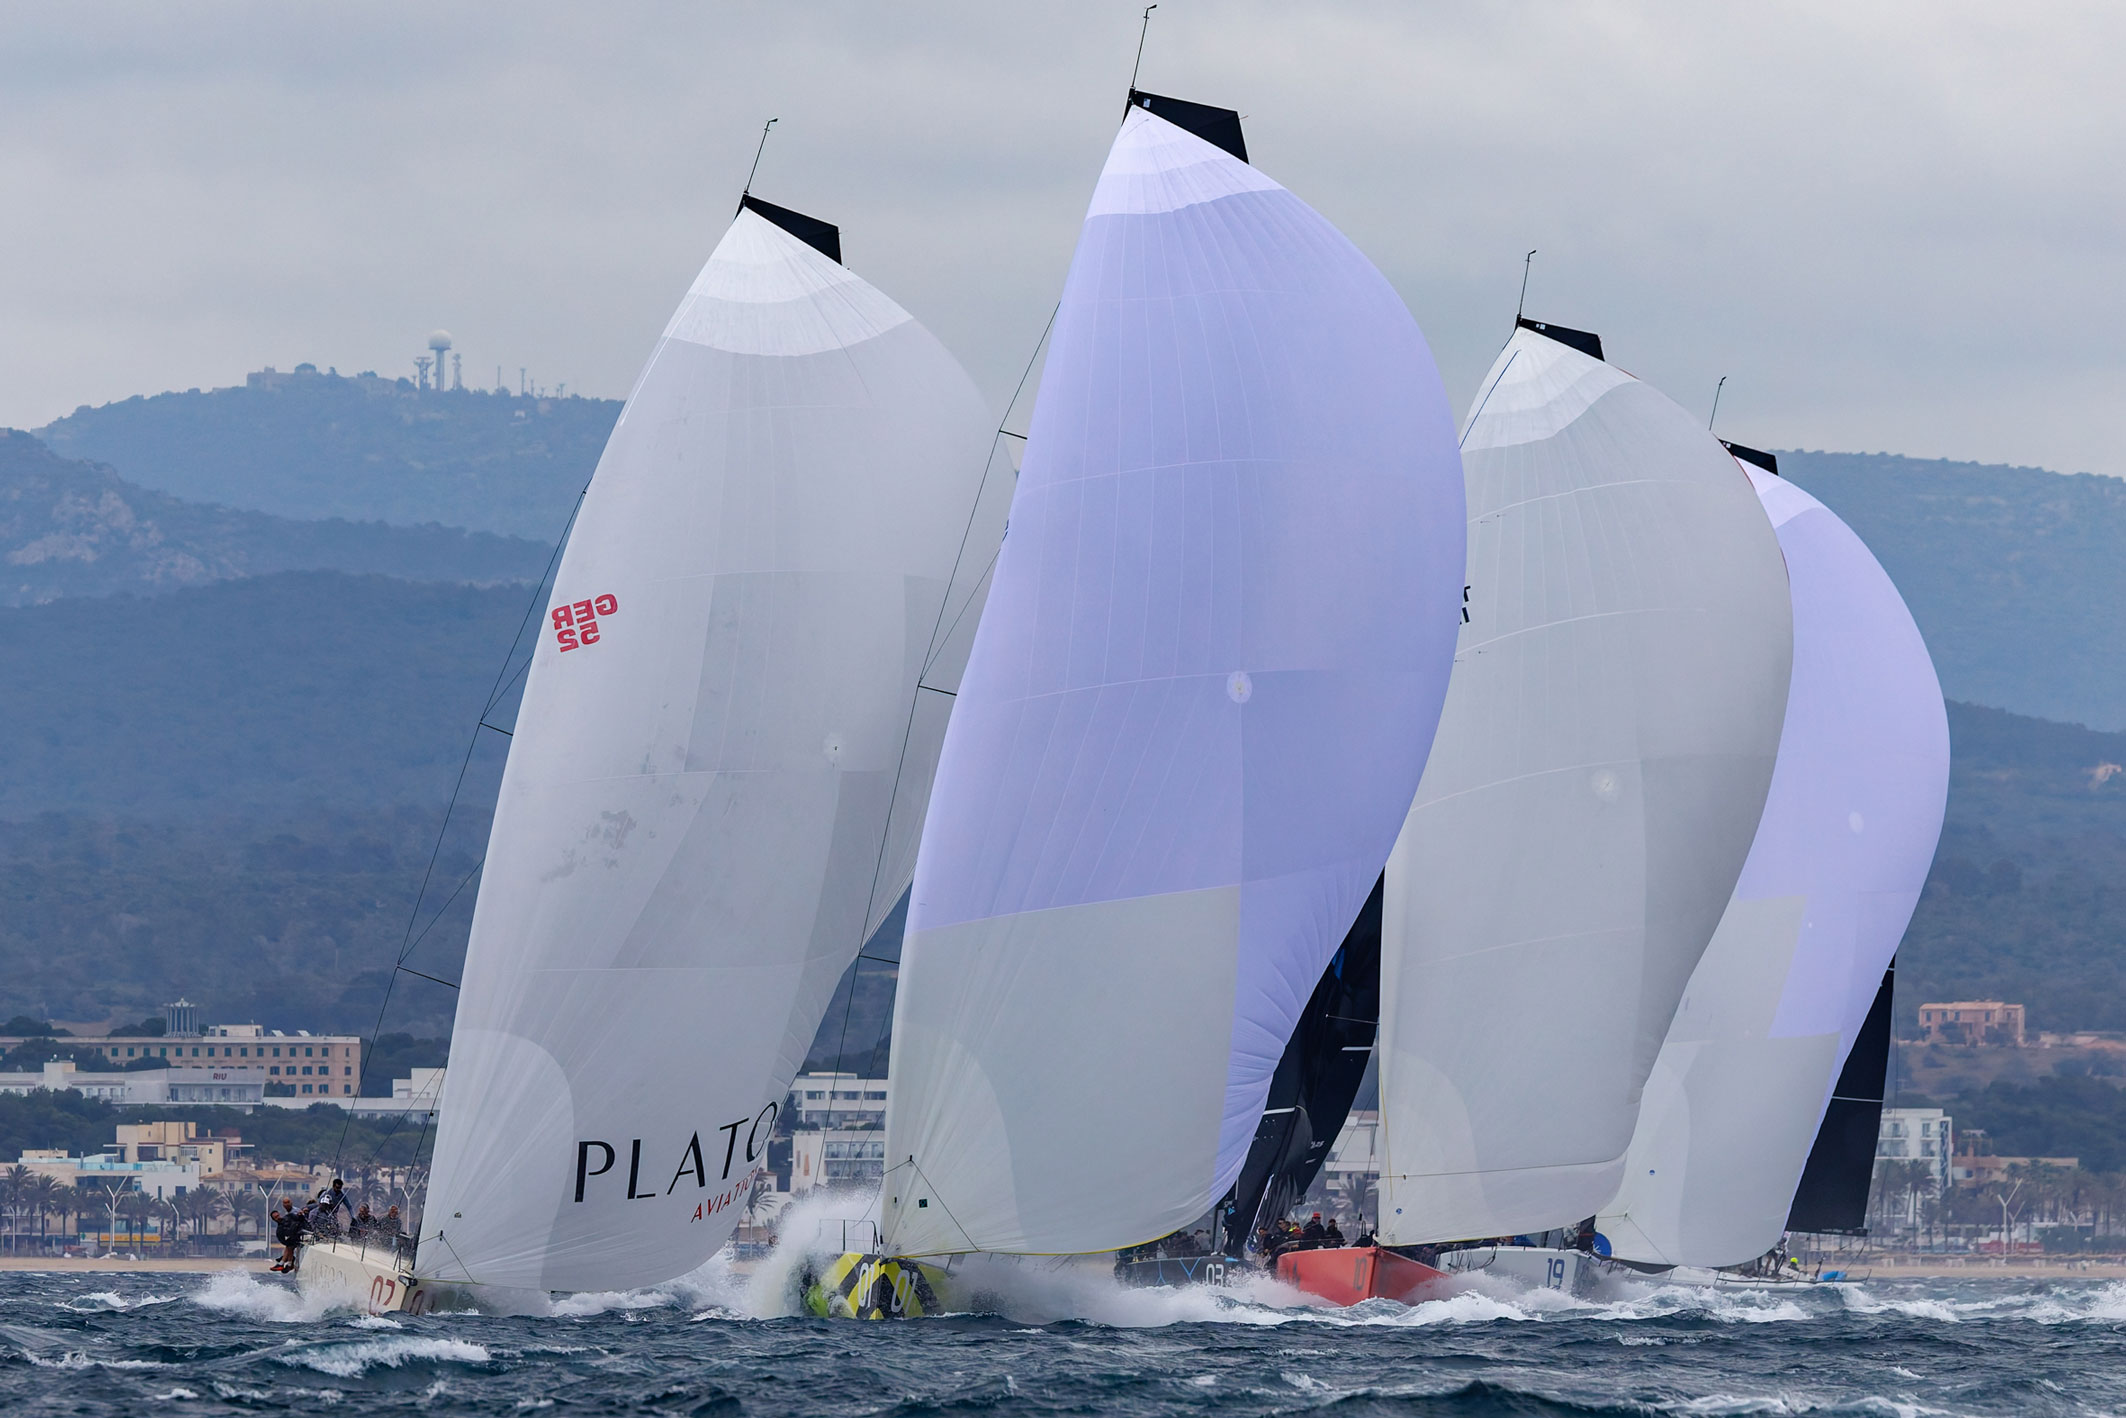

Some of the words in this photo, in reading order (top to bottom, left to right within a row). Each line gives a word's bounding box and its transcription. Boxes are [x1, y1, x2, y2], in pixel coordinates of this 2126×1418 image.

[213, 1072, 227, 1080] RIU
[1547, 1257, 1565, 1290] 19
[890, 1269, 919, 1315] 01
